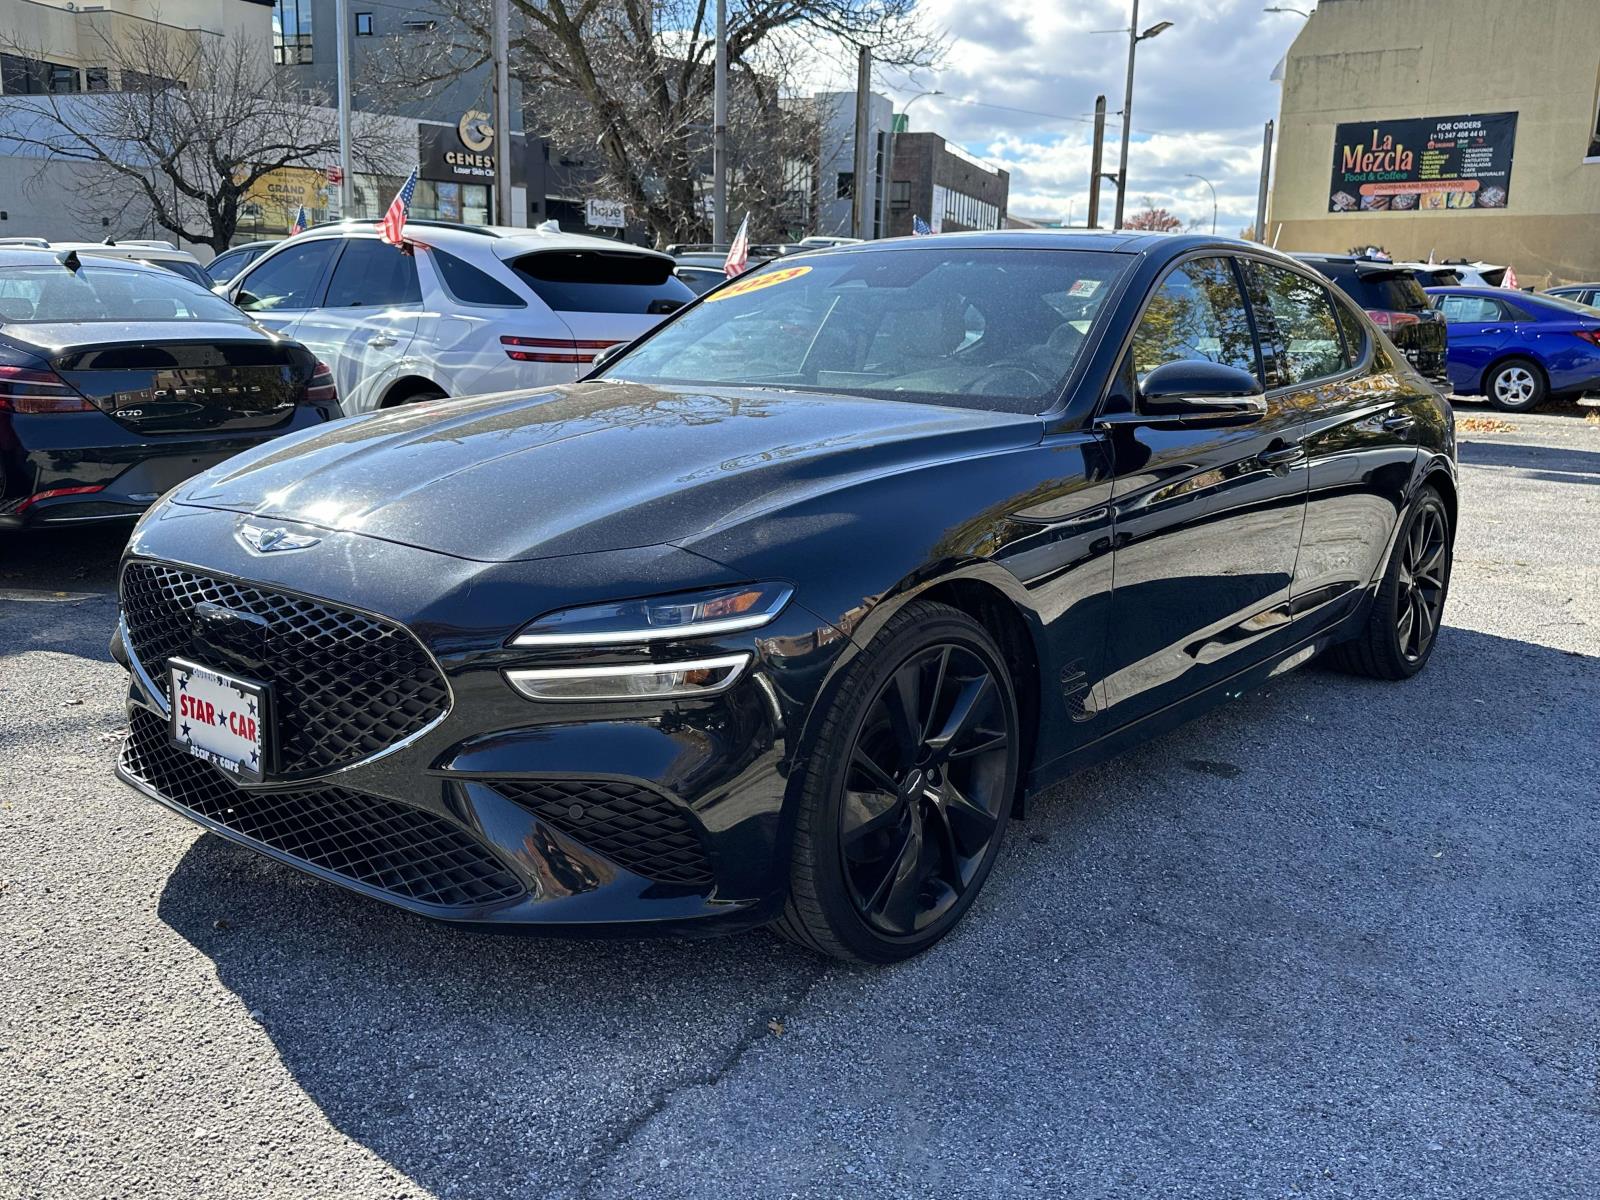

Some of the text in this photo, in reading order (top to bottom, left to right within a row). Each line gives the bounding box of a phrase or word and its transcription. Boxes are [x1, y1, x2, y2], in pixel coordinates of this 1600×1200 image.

[1436, 121, 1482, 131] FOR ORDERS
[1371, 128, 1392, 151] La
[445, 151, 495, 168] GENES
[1341, 143, 1413, 173] Mezcla
[453, 166, 470, 175] Laser
[471, 168, 485, 177] Skin
[1344, 170, 1408, 182] Food & Coffee
[267, 183, 305, 195] GRAND
[154, 386, 261, 396] GENESIS
[116, 409, 143, 417] G70
[180, 694, 216, 727] STAR
[229, 711, 257, 743] CAR
[219, 756, 240, 774] cars
